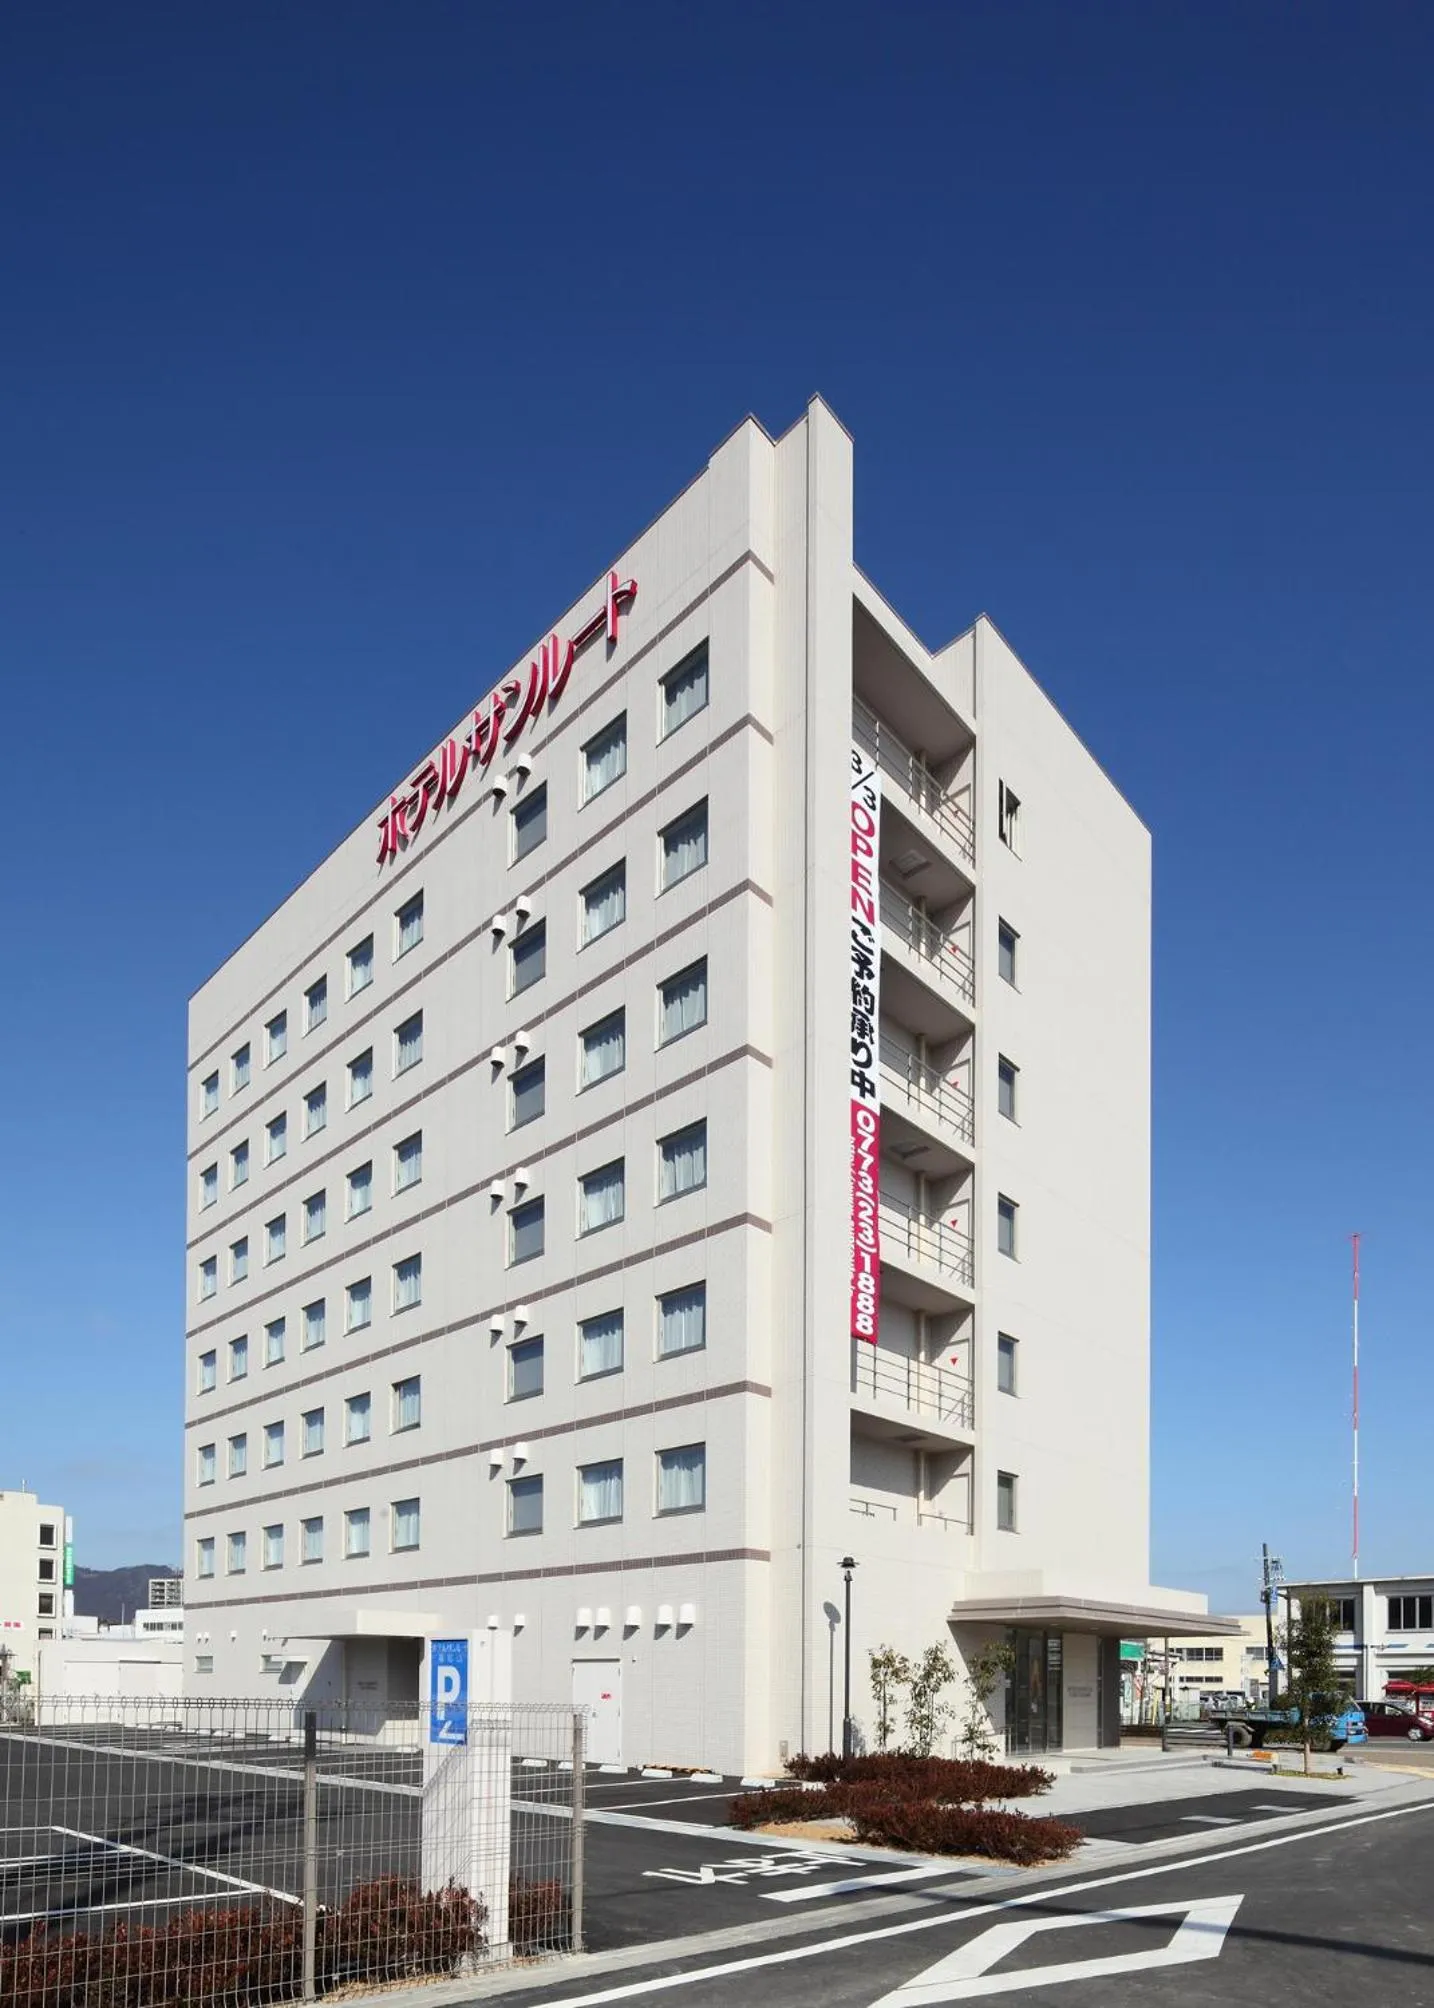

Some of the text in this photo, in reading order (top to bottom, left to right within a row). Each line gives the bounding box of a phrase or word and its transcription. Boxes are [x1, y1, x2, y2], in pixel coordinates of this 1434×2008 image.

[851, 749, 877, 811] 3/3
[851, 801, 876, 926] OPEN
[437, 1665, 461, 1720] P
